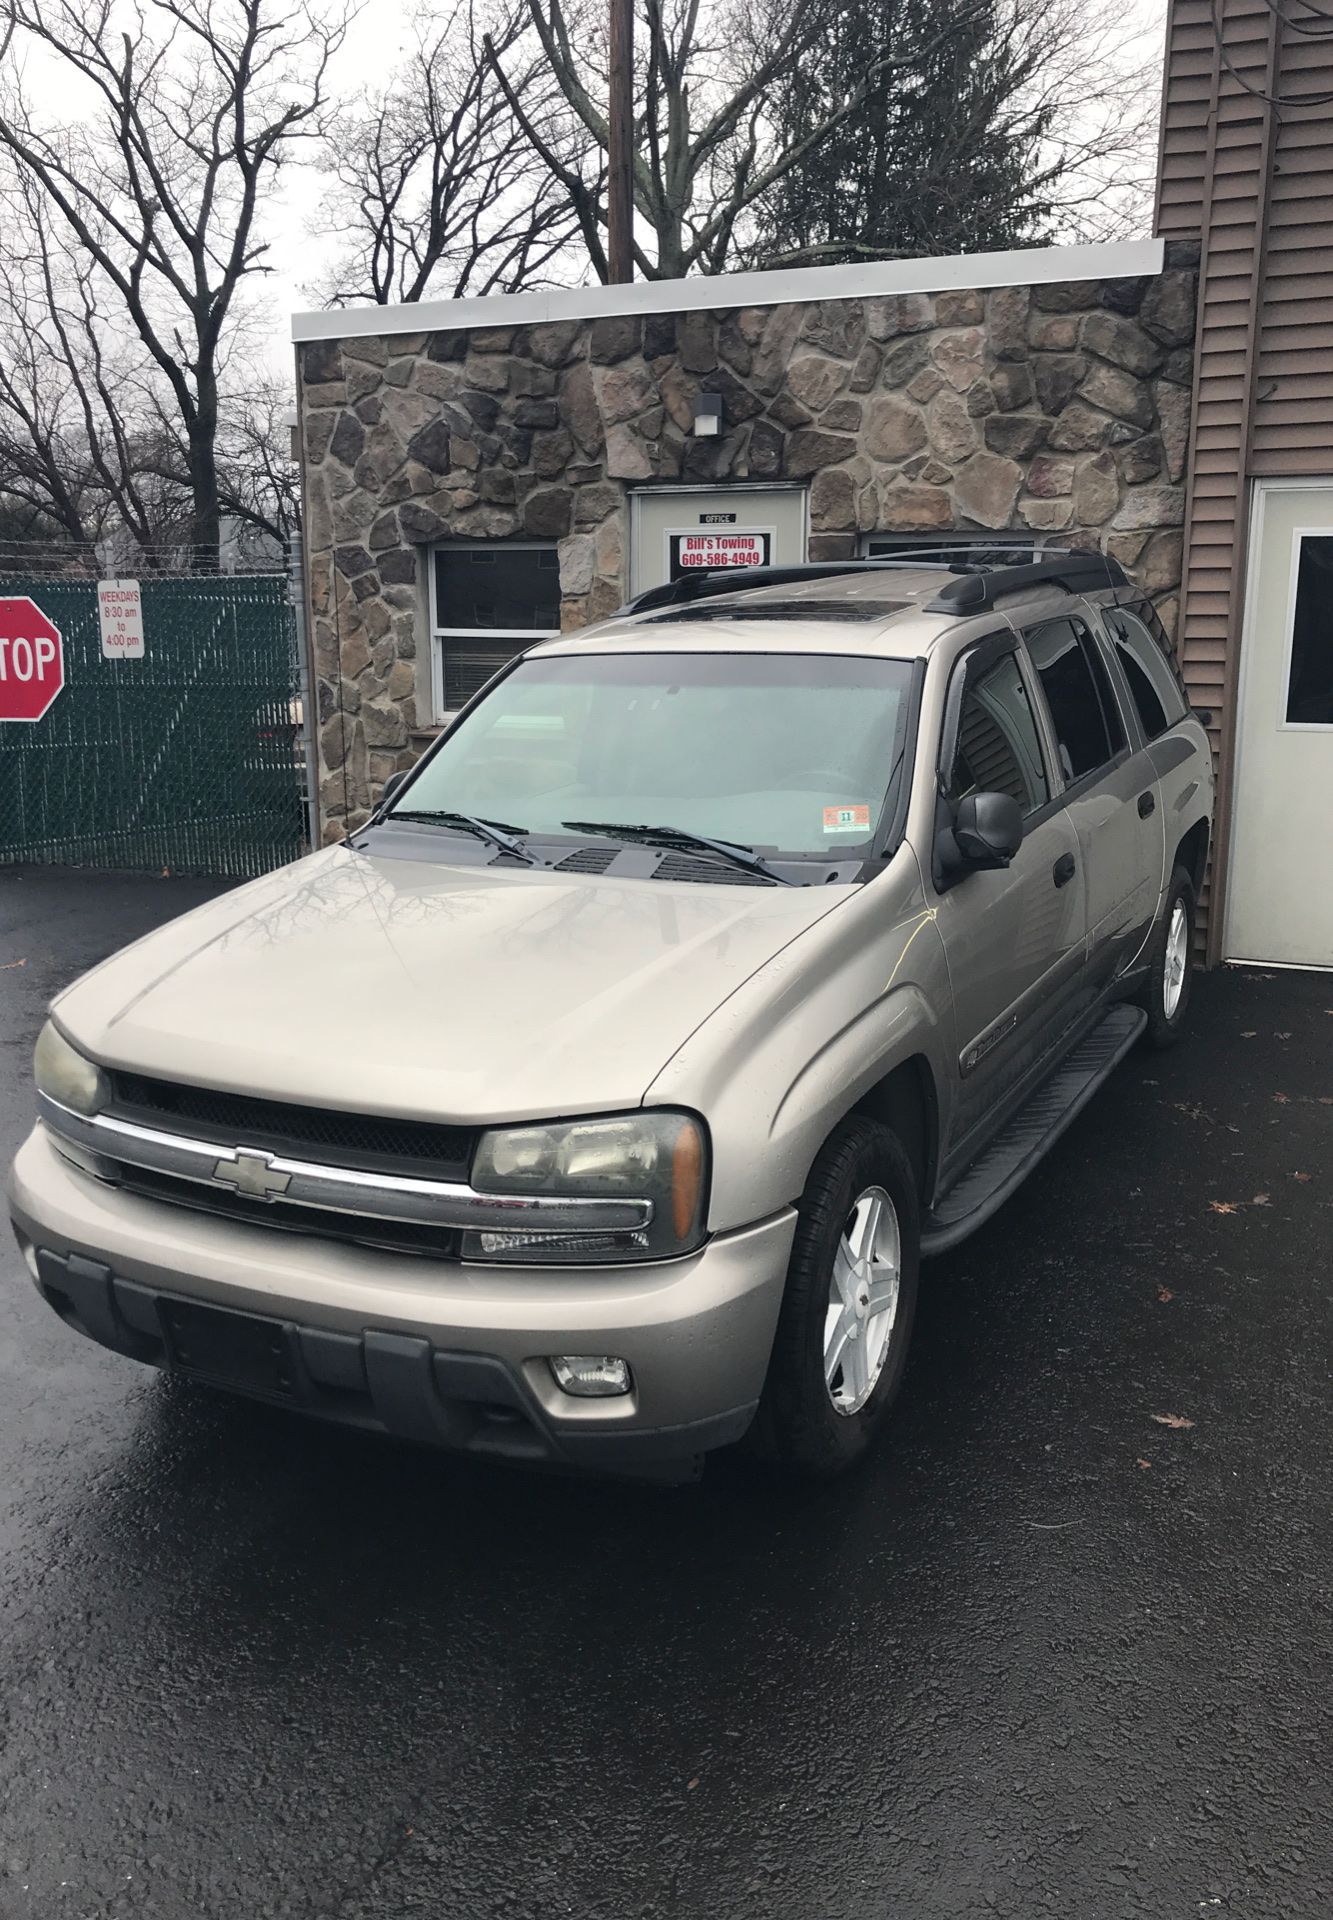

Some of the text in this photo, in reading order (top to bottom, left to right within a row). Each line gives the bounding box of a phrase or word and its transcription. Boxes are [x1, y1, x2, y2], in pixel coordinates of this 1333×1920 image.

[705, 514, 730, 523] OFFICE
[686, 536, 755, 550] Bill's Towing
[682, 552, 760, 566] 609-586-4949
[100, 590, 140, 603] WEEKDAYS
[104, 606, 137, 618] 8:30 am
[117, 621, 126, 632] to
[106, 634, 140, 648] 4:00 pm
[0, 637, 56, 681] TOP
